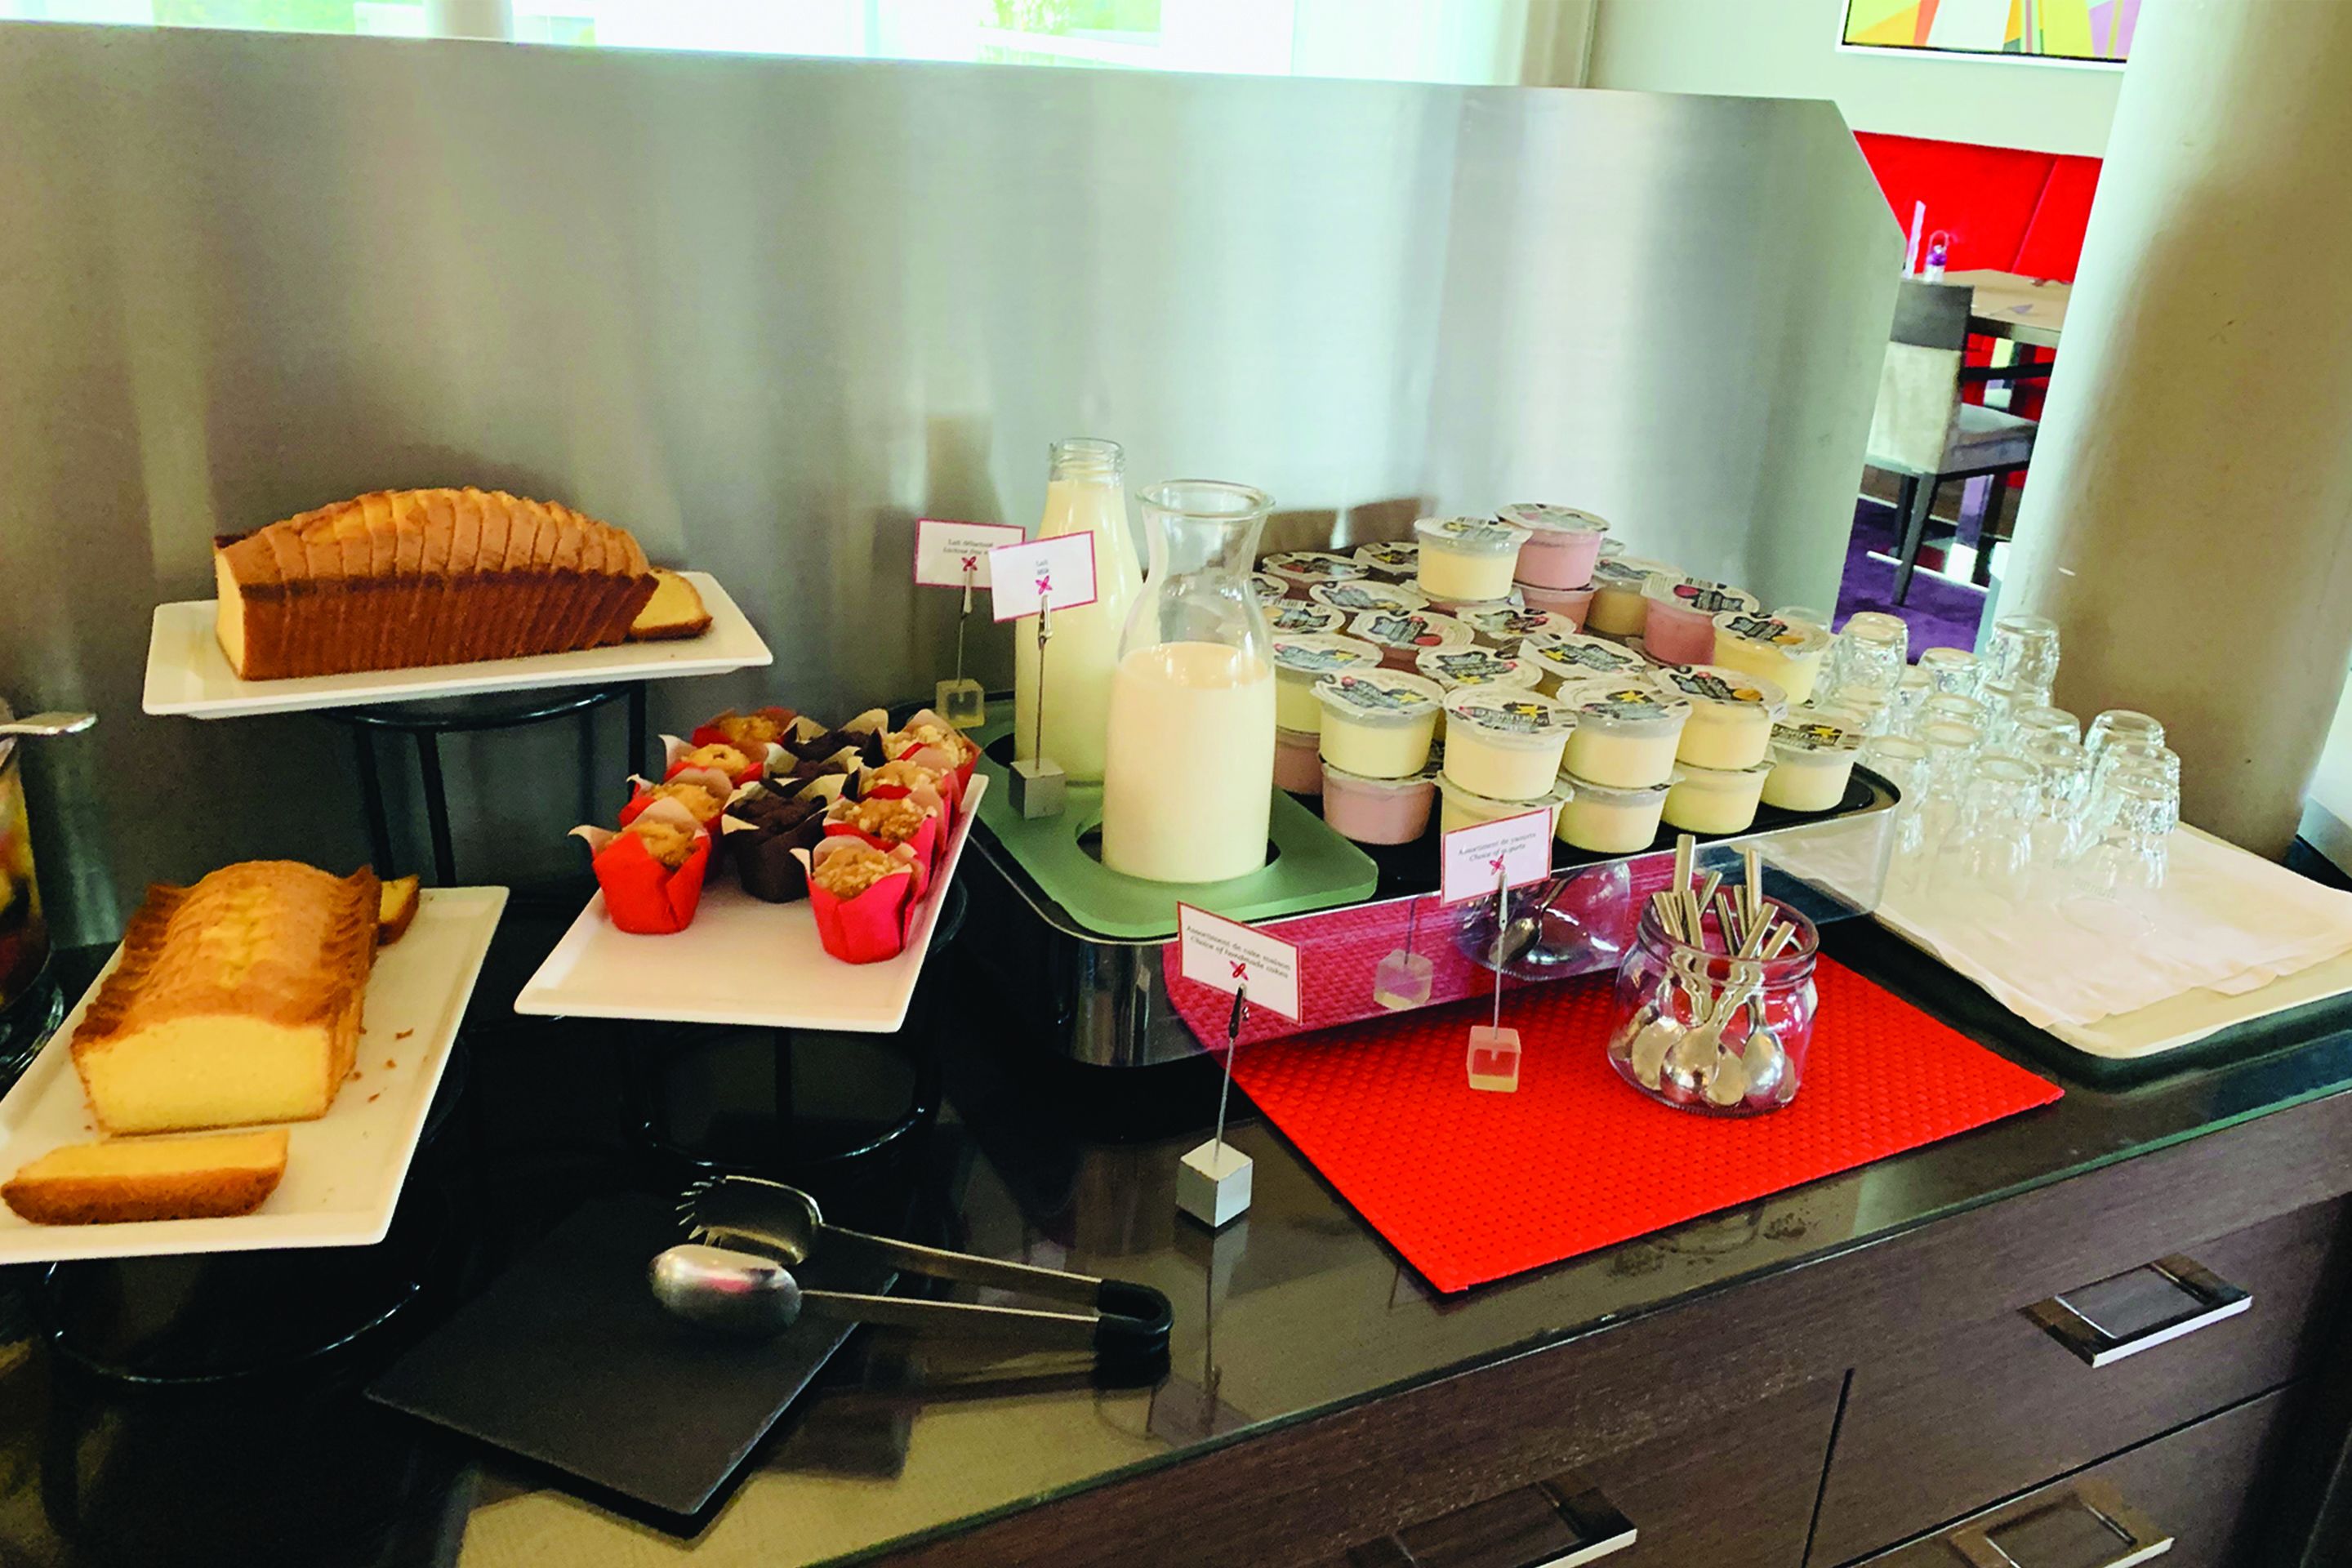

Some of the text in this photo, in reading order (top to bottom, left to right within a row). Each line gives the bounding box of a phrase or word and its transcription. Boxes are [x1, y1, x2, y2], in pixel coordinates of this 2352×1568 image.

[1500, 838, 1509, 846] de
[1469, 852, 1491, 862] Choice
[1494, 848, 1501, 857] of
[1190, 935, 1214, 950] Choice
[1215, 947, 1224, 955] of
